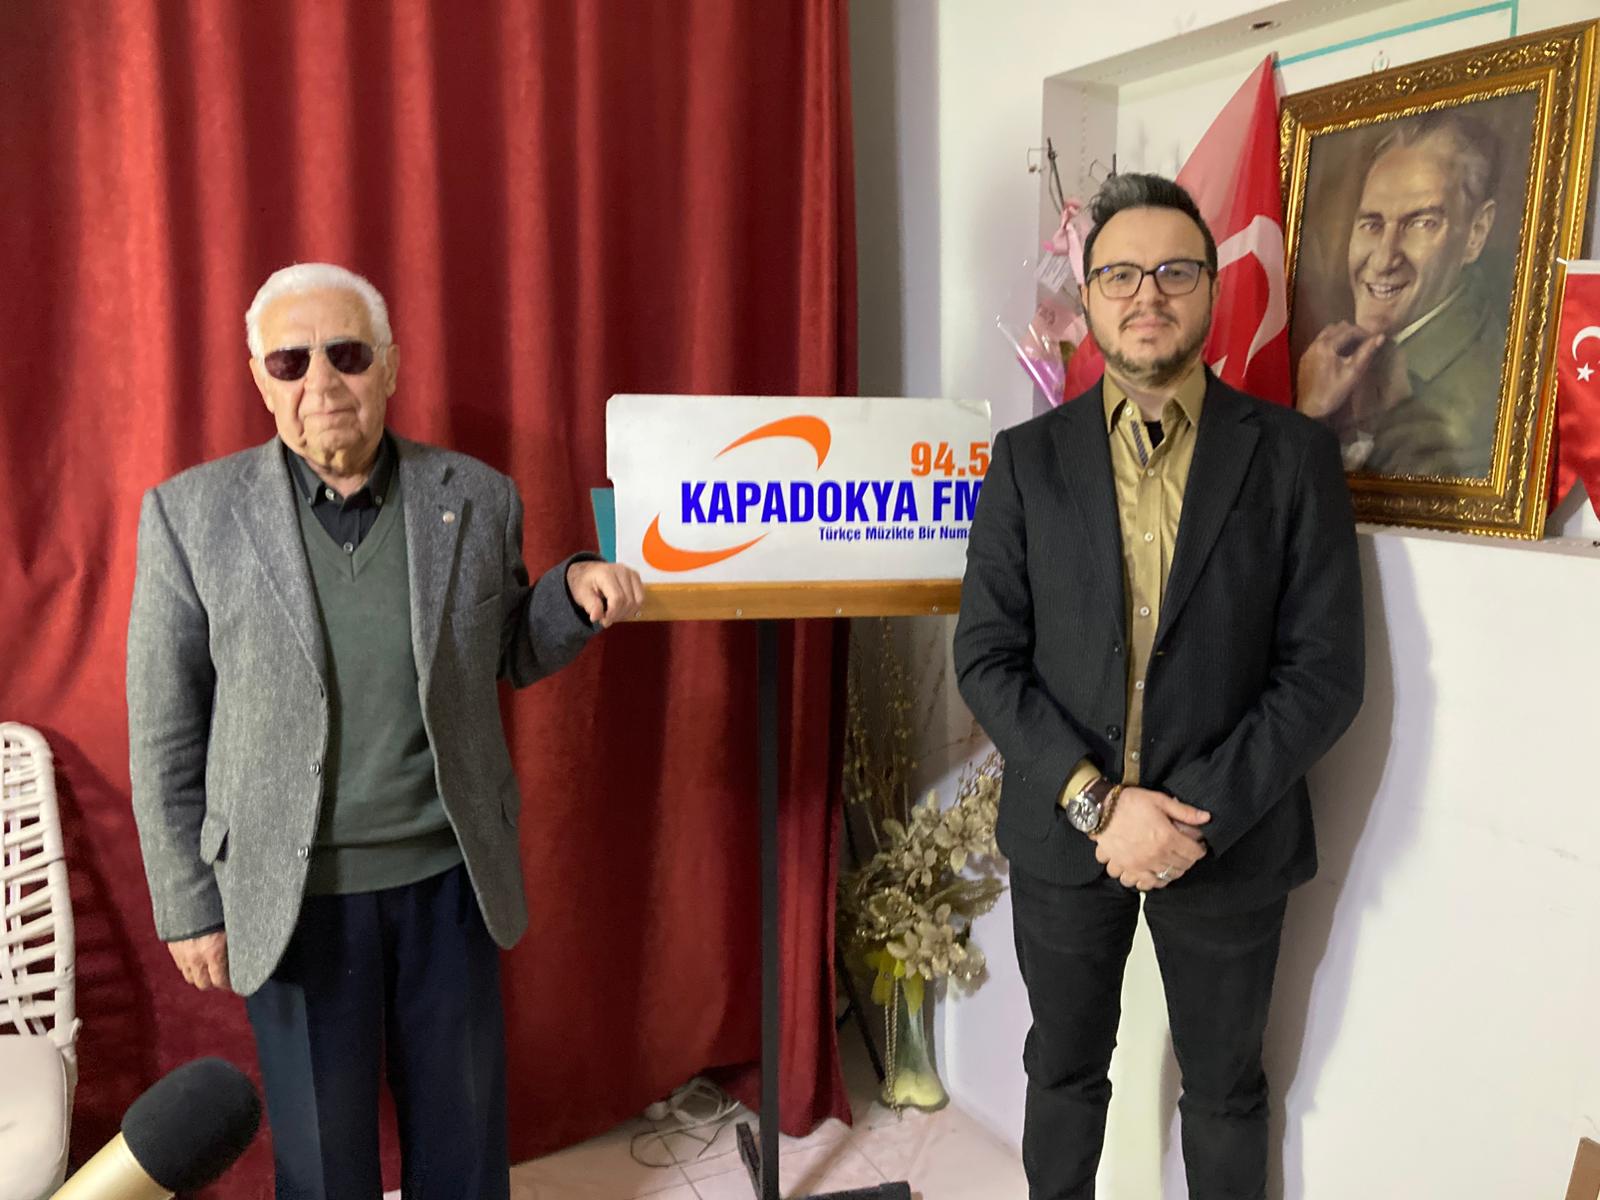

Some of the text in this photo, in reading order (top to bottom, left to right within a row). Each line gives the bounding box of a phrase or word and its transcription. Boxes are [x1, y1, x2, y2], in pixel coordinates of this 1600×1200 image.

[911, 441, 990, 477] 94.5
[681, 480, 984, 523] KAPADOKYA FM
[819, 524, 969, 541] Türkçe Müzikte Bir Num
